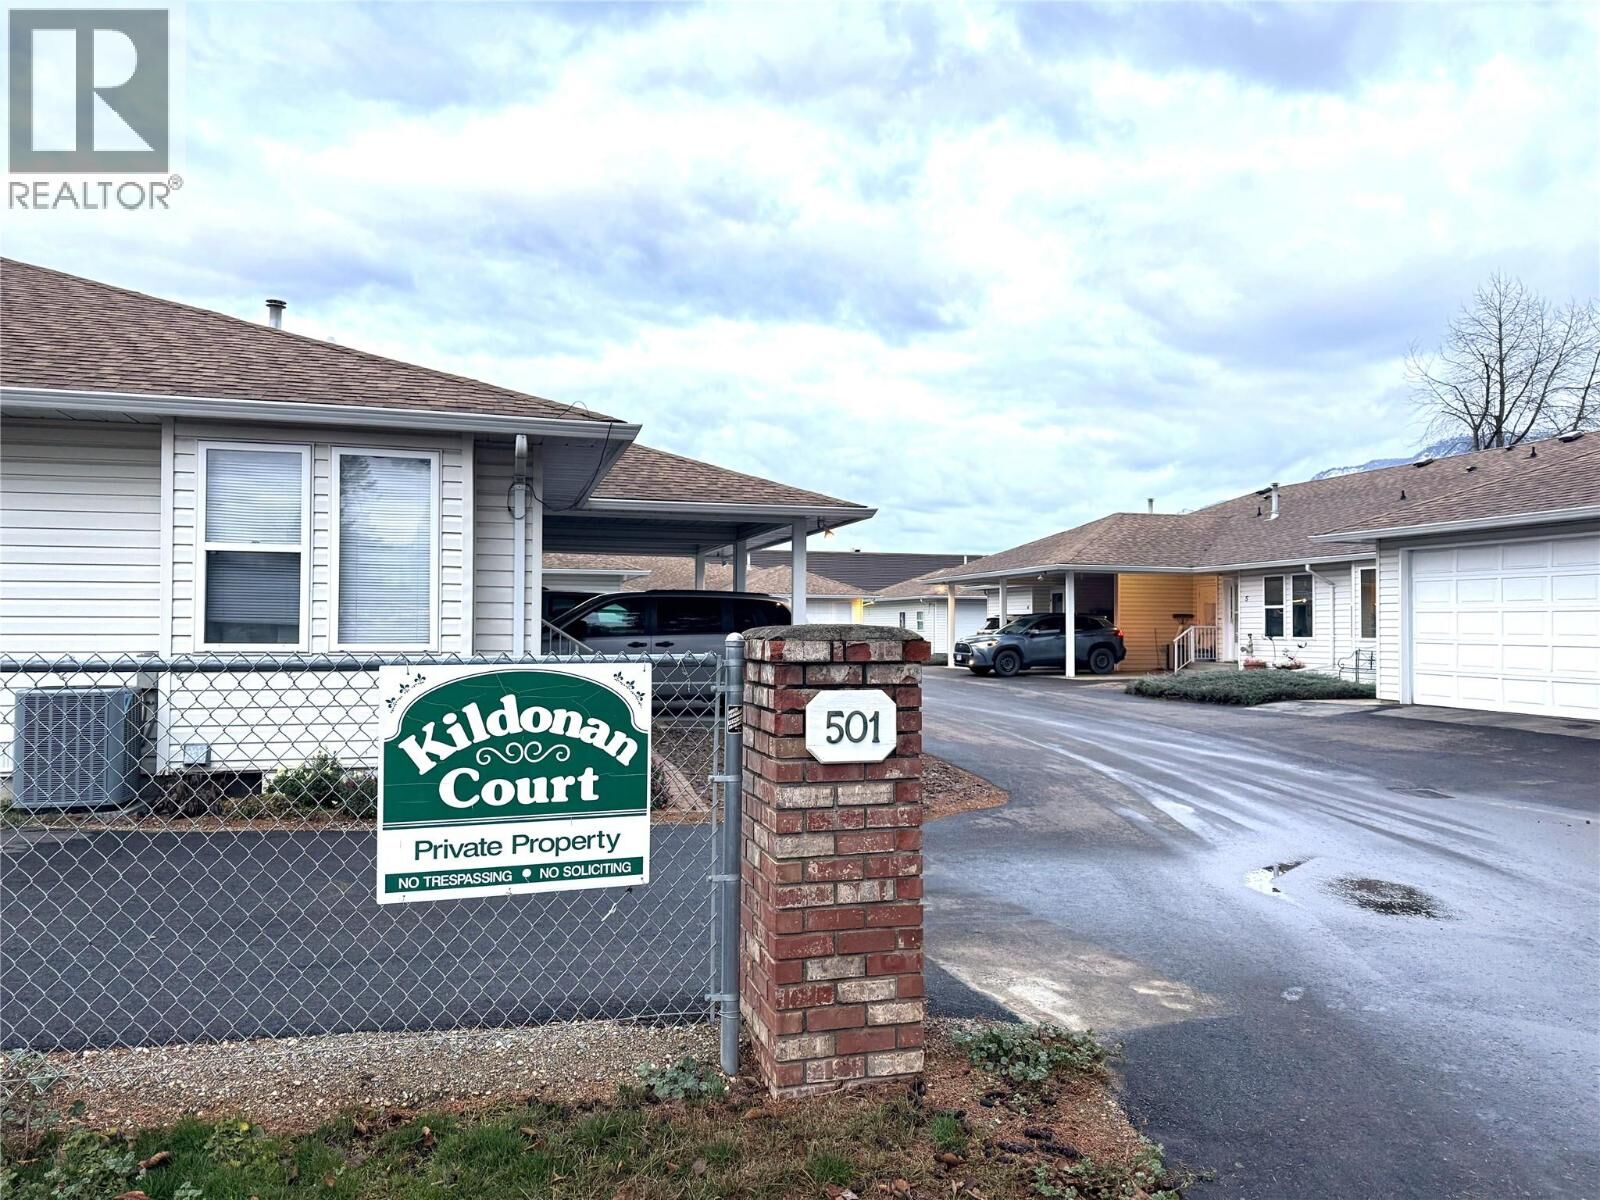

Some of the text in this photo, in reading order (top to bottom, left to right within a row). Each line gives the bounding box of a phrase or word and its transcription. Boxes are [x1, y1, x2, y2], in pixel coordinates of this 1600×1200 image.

[398, 694, 638, 776] Kildonan
[826, 710, 880, 744] 501
[438, 767, 600, 809] Court
[414, 830, 621, 861] Private Property
[398, 861, 632, 889] NO TRESPASSING NO SOLICITING
